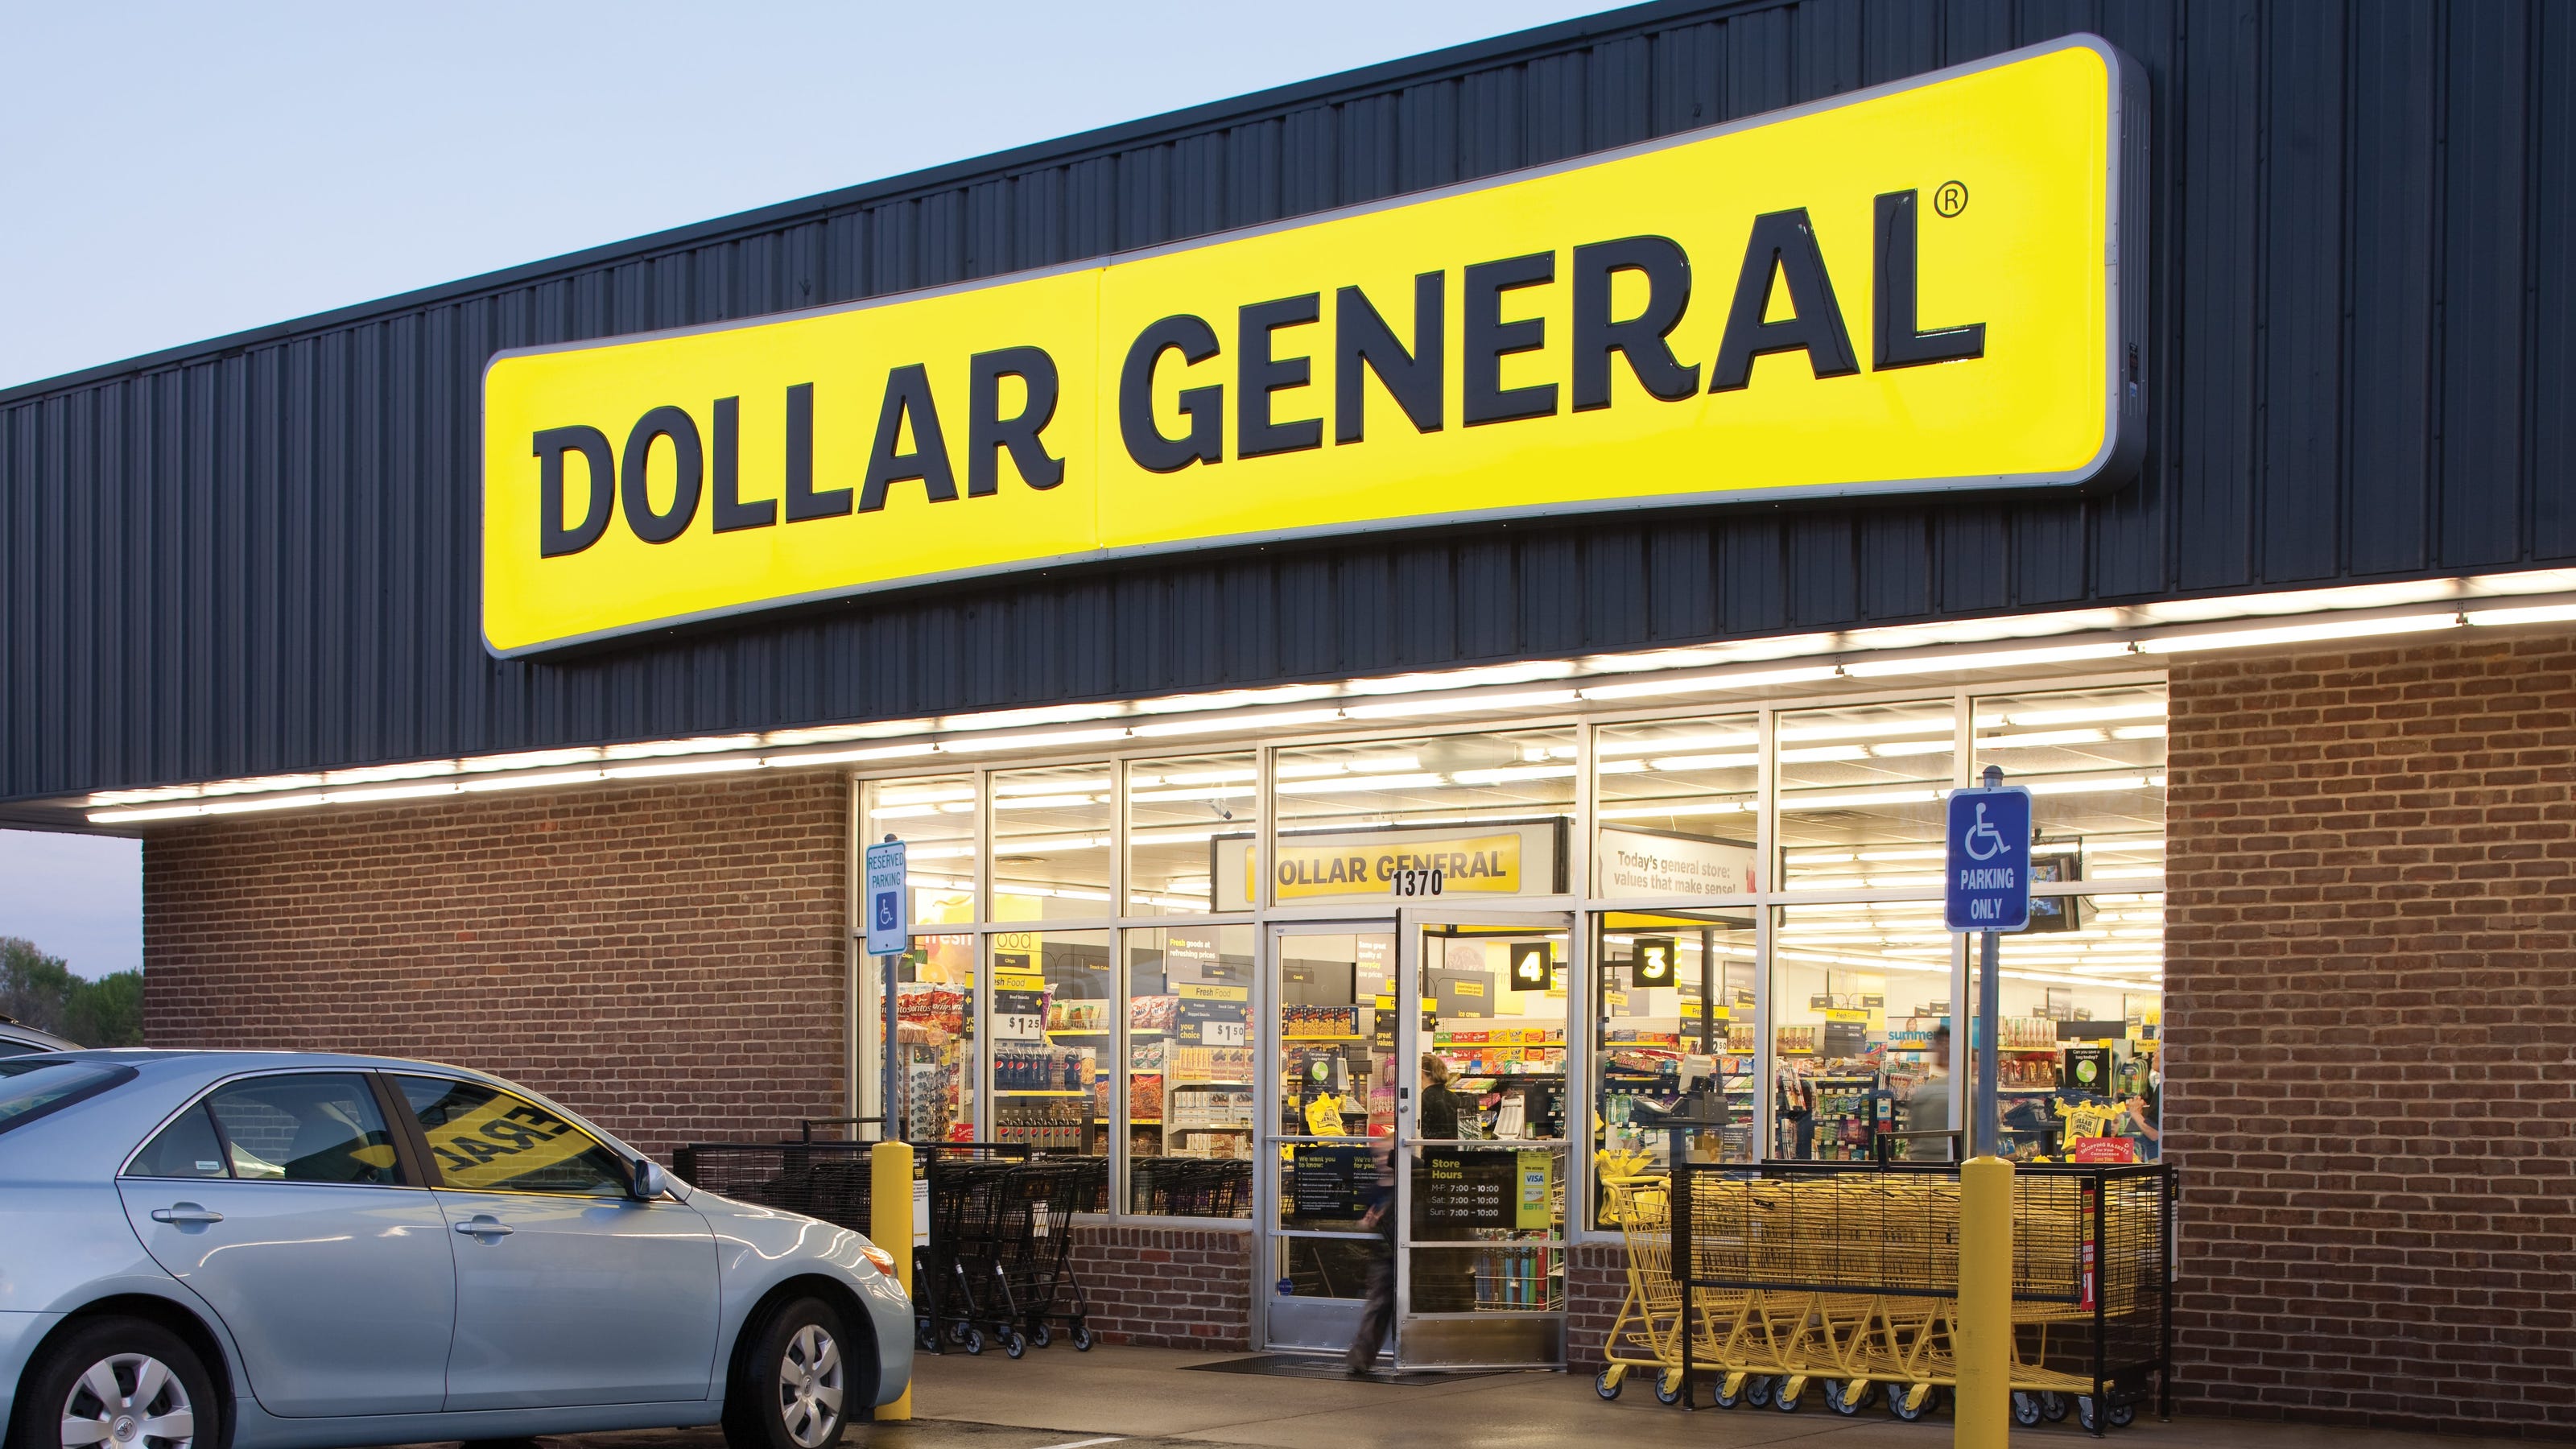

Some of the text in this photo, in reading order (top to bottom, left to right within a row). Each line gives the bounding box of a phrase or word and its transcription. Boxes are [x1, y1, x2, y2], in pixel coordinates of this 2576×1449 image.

[533, 344, 1066, 559] DOLLAR
[1118, 189, 1988, 473] GENERAL
[869, 852, 904, 870] RESERVED
[1617, 850, 1731, 879] Today's general store:
[1278, 857, 1368, 886] OLLAR
[872, 871, 901, 889] PARKING
[1393, 869, 1442, 896] 1370
[1613, 871, 1648, 888] values
[1650, 874, 1672, 891] that
[1674, 878, 1703, 894] make
[1960, 868, 2014, 890] PARKING
[1971, 898, 2003, 919] ONLY
[997, 932, 1031, 949] ood
[1170, 938, 1186, 947] Fresh
[1186, 939, 1203, 949] goods
[1358, 941, 1386, 952] Same great
[1170, 950, 1216, 960] refreshing prices
[1358, 952, 1373, 960] quality
[1518, 952, 1543, 982] 4
[1642, 947, 1666, 979] 3
[1368, 971, 1383, 980] prices
[1496, 970, 1510, 985] rin
[1006, 977, 1025, 987] Food
[1195, 988, 1232, 997] Fresh Food
[965, 1017, 974, 1025] yo
[1180, 1023, 1195, 1031] your
[1180, 1030, 1200, 1039] choice
[1377, 1031, 1392, 1040] great
[1888, 1030, 1934, 1041] summe
[2080, 1143, 2129, 1154] SHOPPING BASKETS
[1431, 1158, 1460, 1168] Store
[1431, 1170, 1463, 1179] Hours
[1526, 1174, 1544, 1183] VISA
[1450, 1184, 1469, 1192] 7:00
[1477, 1184, 1500, 1193] 10:00
[1431, 1195, 1446, 1203] Sat:
[1450, 1196, 1469, 1204] 7:00
[1477, 1196, 1500, 1204] 10:00
[1430, 1208, 1446, 1216] Sun:
[1449, 1208, 1469, 1217] 7:00
[1477, 1208, 1499, 1217] 10:00
